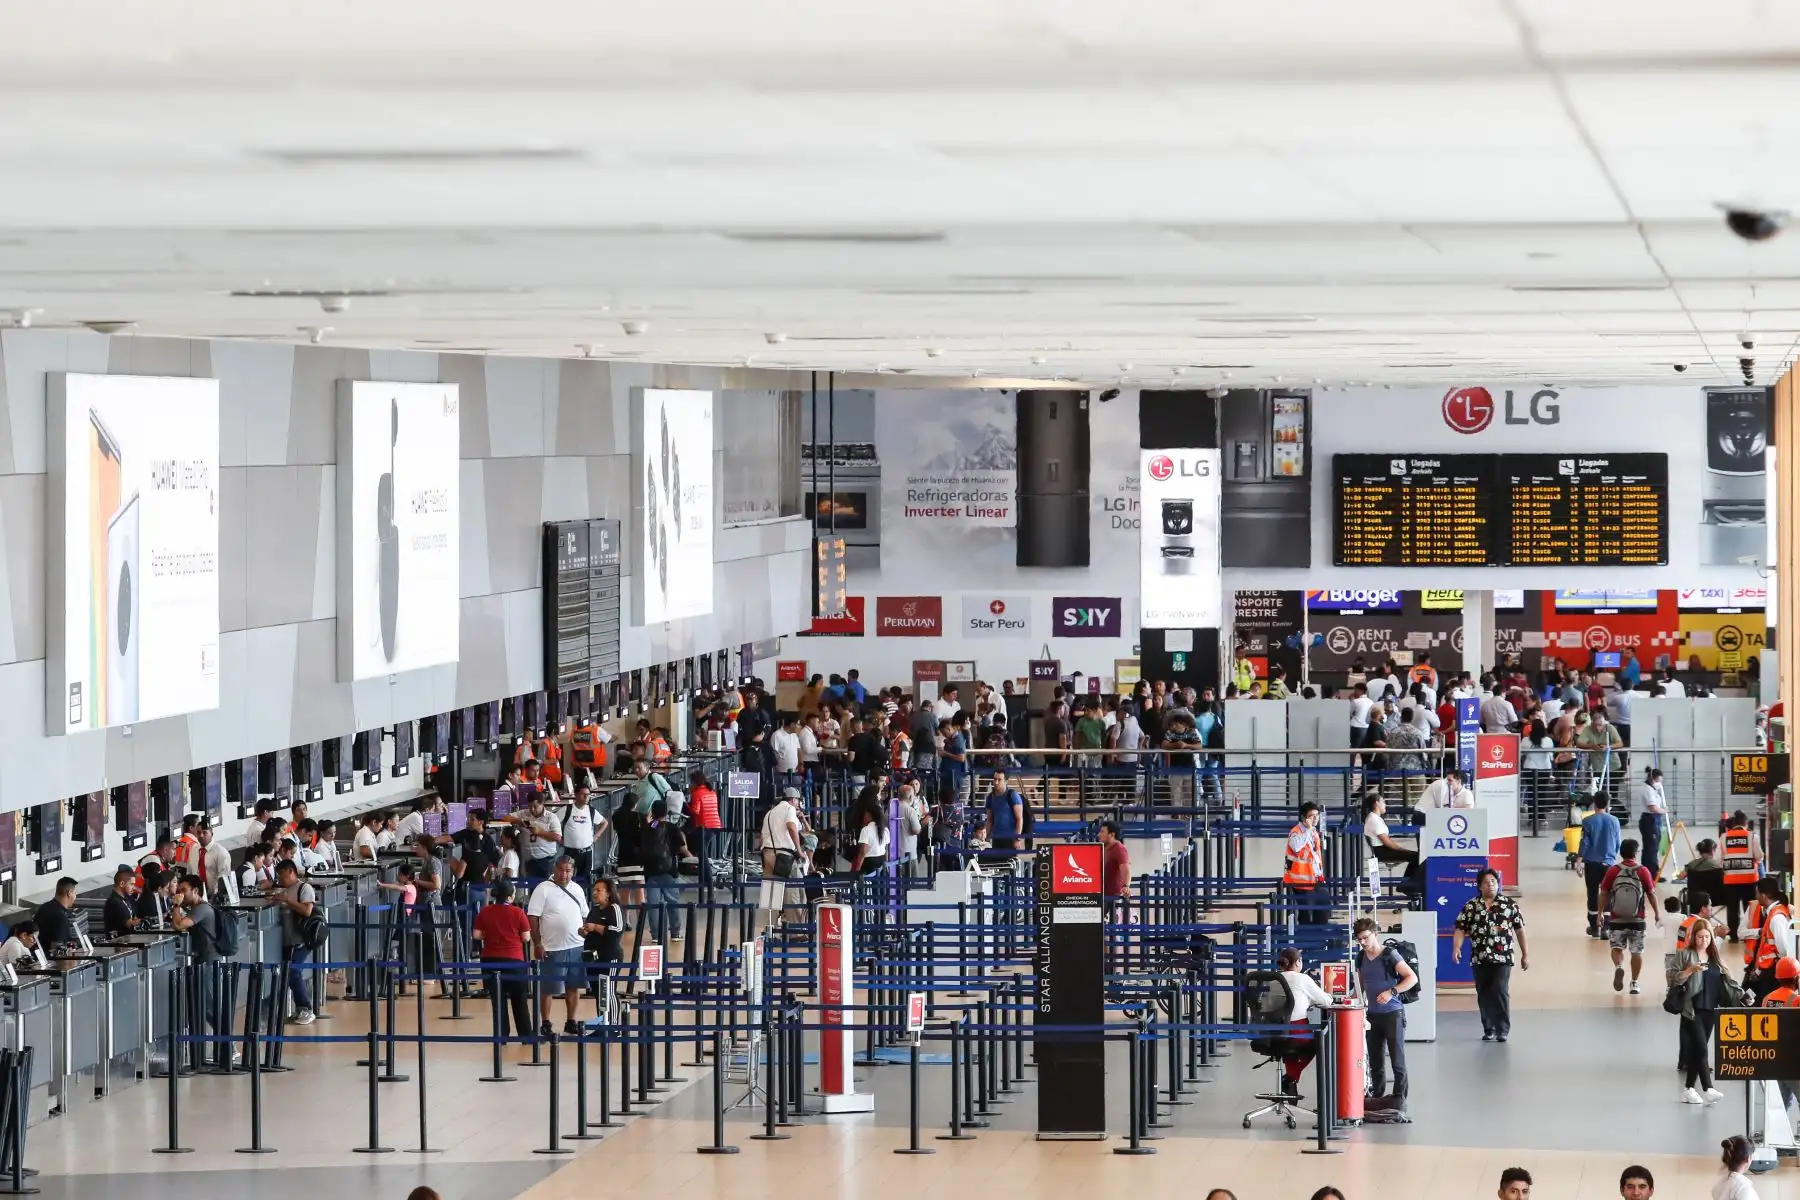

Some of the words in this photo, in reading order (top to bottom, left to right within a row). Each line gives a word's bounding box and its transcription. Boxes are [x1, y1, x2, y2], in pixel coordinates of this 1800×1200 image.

[1505, 389, 1560, 425] LG
[1181, 459, 1210, 477] LG
[907, 488, 1008, 504] Refrigeradoras
[1104, 498, 1125, 511] LG
[904, 505, 961, 517] Inverter
[966, 505, 1008, 517] Linear
[884, 617, 935, 628] PERUVIAN
[1063, 608, 1111, 626] SKY
[970, 619, 995, 629] Star
[998, 618, 1025, 629] Perú
[1357, 629, 1392, 640] RENT
[1614, 635, 1641, 646] BUS
[1357, 641, 1367, 652] A
[1372, 641, 1399, 652] CAR
[1496, 641, 1523, 652] CAR
[1733, 774, 1766, 783] Teléfono
[1433, 838, 1480, 849] ATSA
[1040, 862, 1050, 900] GOLD
[1063, 875, 1092, 883] Avianca
[1040, 907, 1050, 973] ALLIANCE
[1041, 978, 1050, 1013] STAR
[1720, 1045, 1776, 1060] Teléfono
[1720, 1064, 1755, 1075] Phone
